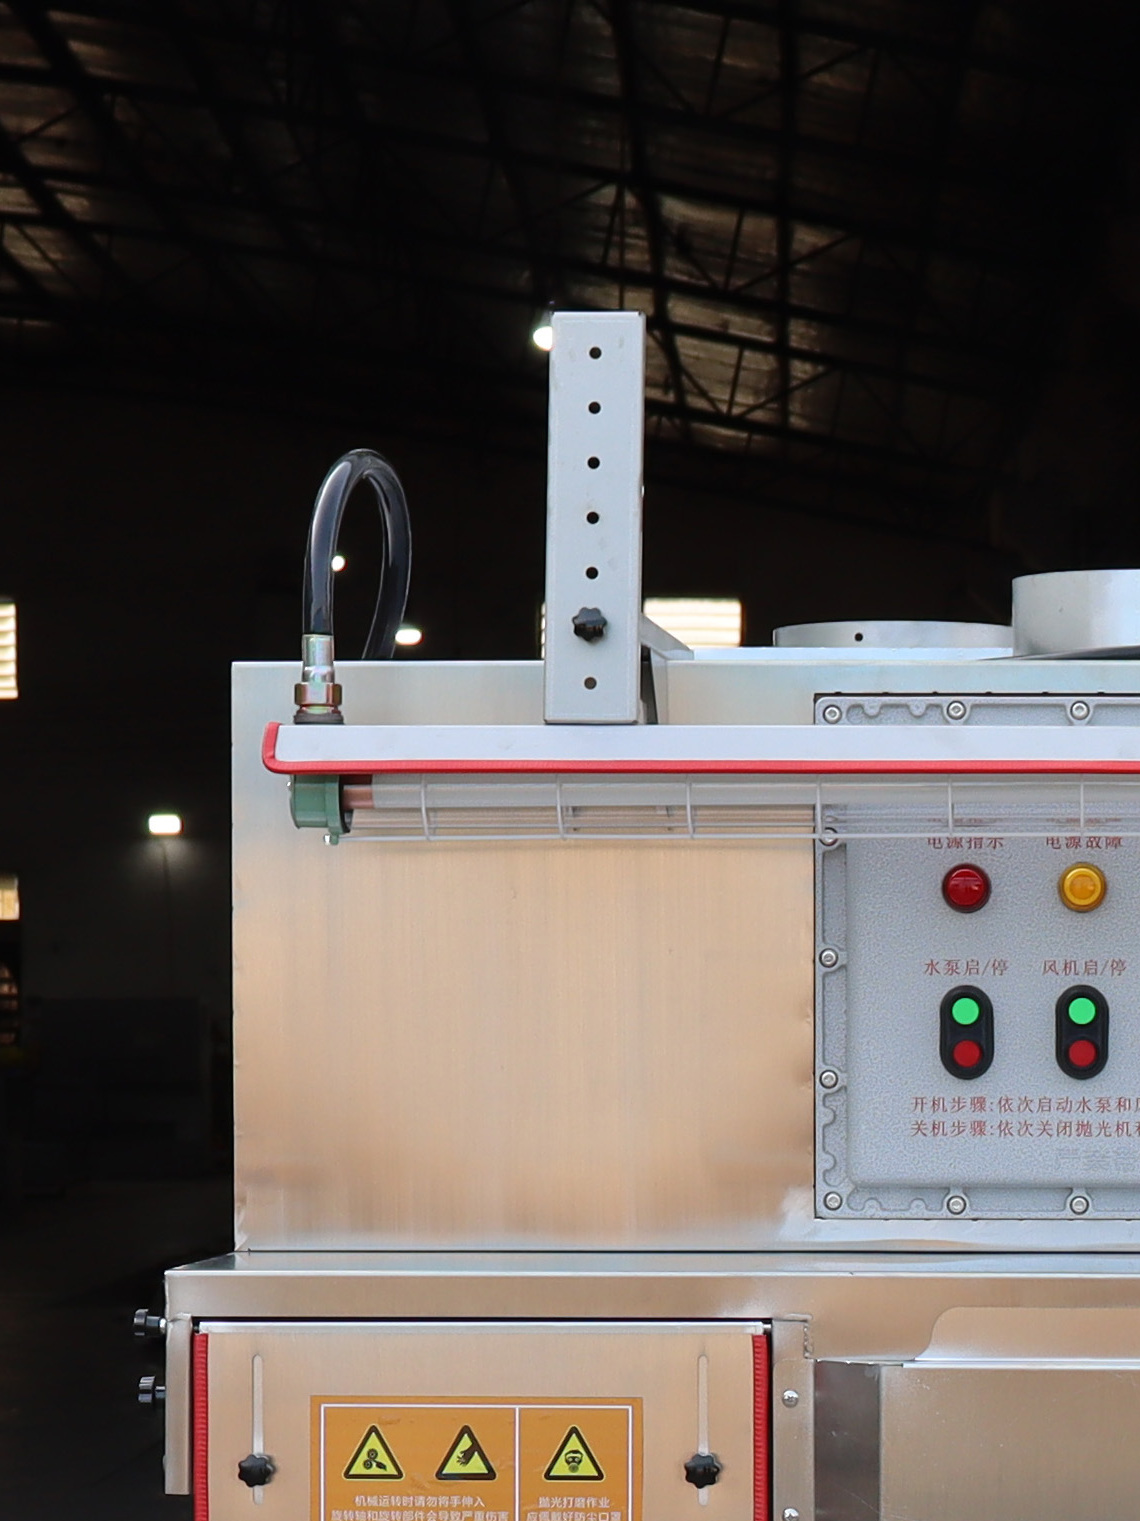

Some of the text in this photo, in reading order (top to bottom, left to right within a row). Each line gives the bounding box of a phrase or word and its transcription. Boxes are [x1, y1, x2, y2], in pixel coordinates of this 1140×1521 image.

[927, 836, 1005, 850] 电源指示
[1046, 836, 1124, 850] 电源故障
[924, 958, 1009, 977] 水泵启/停
[1042, 958, 1127, 977] 风机启/停
[354, 1494, 486, 1508] 机械运转时请勿将手伸入
[538, 1496, 611, 1509] 抛光打磨作业
